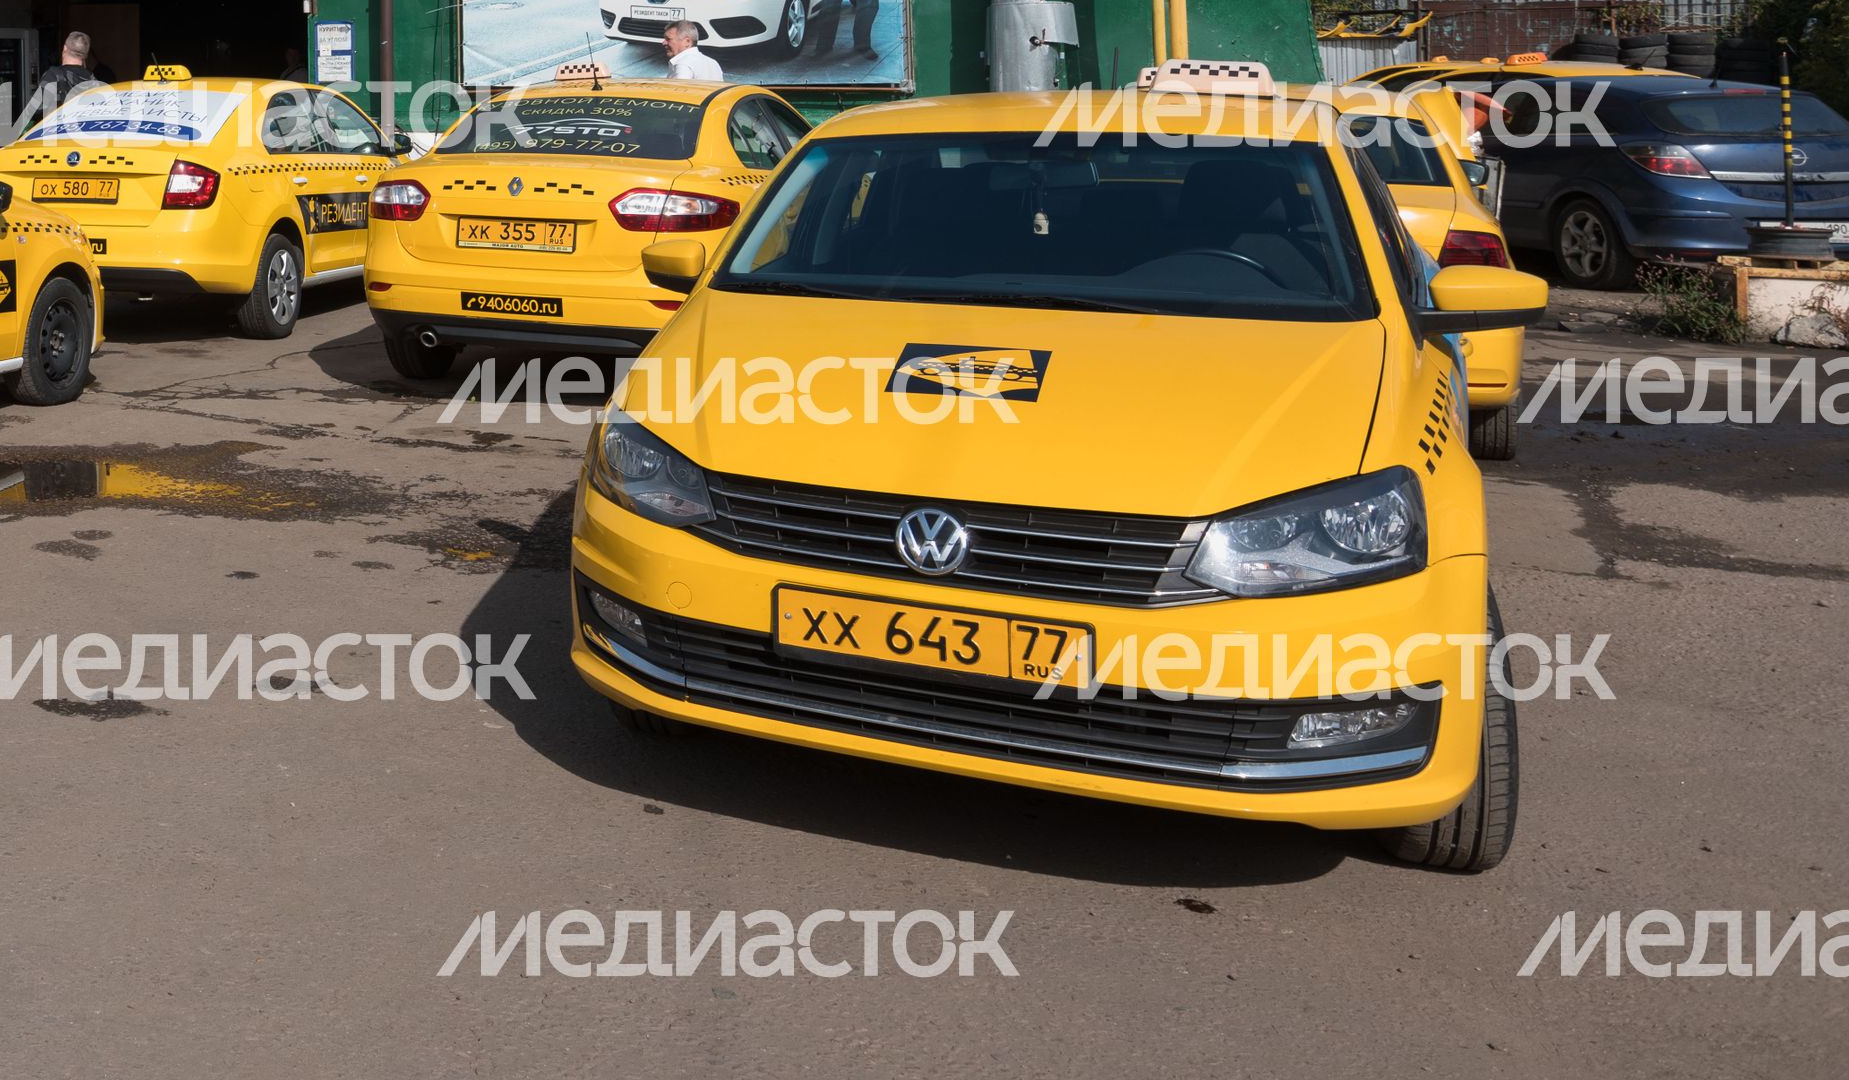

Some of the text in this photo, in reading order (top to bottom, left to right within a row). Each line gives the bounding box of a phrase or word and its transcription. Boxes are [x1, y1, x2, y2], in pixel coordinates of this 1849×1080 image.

[521, 107, 633, 117] СКИДКА 30%
[600, 98, 700, 113] РЕМОНТ
[135, 108, 208, 123] ЛИСТЫ
[89, 121, 182, 135] 767-34-68
[514, 125, 622, 137] 77STO
[473, 138, 641, 154] (495) 979-77-07
[63, 181, 89, 195] 580
[99, 181, 114, 193] 77
[321, 202, 367, 224] РЕЗИДЕНТ
[499, 222, 536, 241] 355
[548, 223, 568, 238] 77
[477, 295, 558, 314] 9406060.ru
[885, 611, 981, 665] 643
[1016, 624, 1068, 664] 77
[1023, 663, 1064, 681] RUS
